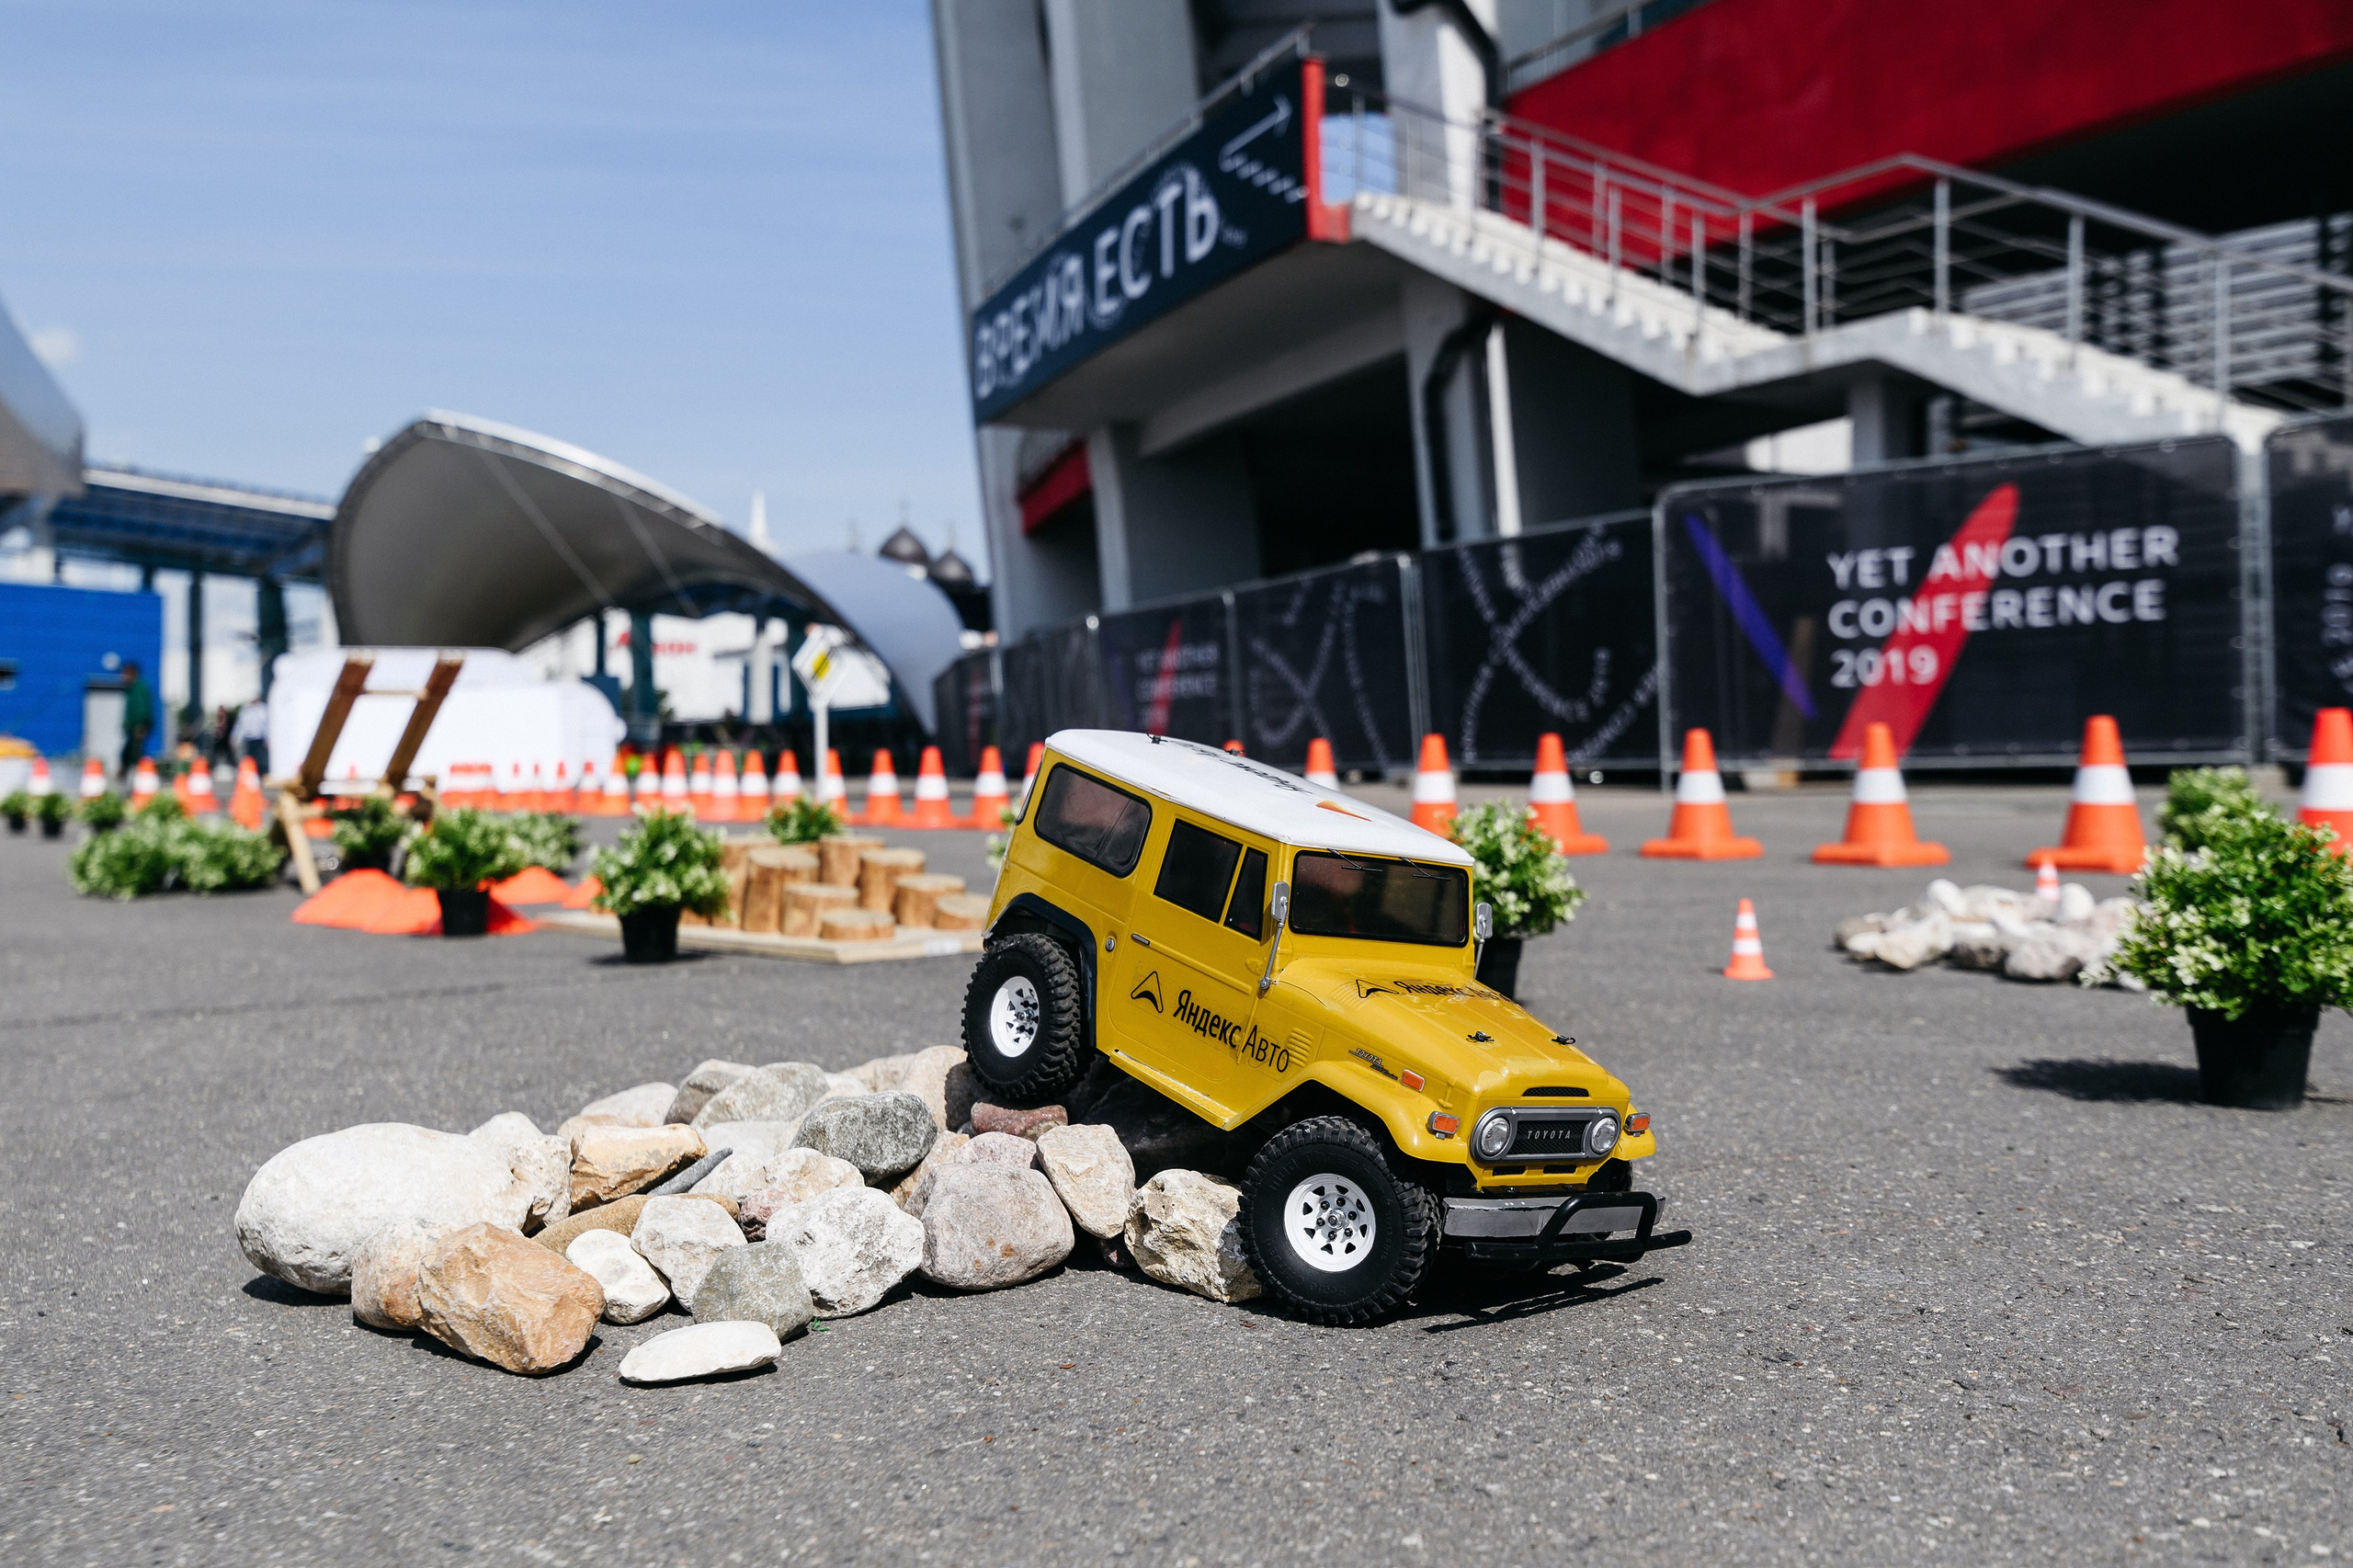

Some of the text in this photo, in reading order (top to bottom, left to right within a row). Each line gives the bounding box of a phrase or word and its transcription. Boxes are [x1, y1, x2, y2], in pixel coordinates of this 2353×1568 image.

[1094, 165, 1220, 316] ЕСТЬ
[1826, 525, 2179, 589] YET ANOTHER
[1827, 578, 2167, 639] CONFERENCE
[1830, 644, 1938, 687] 2019
[1173, 989, 1290, 1073] Яндекс Авто
[1355, 1047, 1383, 1065] TOYOTA
[1527, 1130, 1571, 1140] TOYOTA
